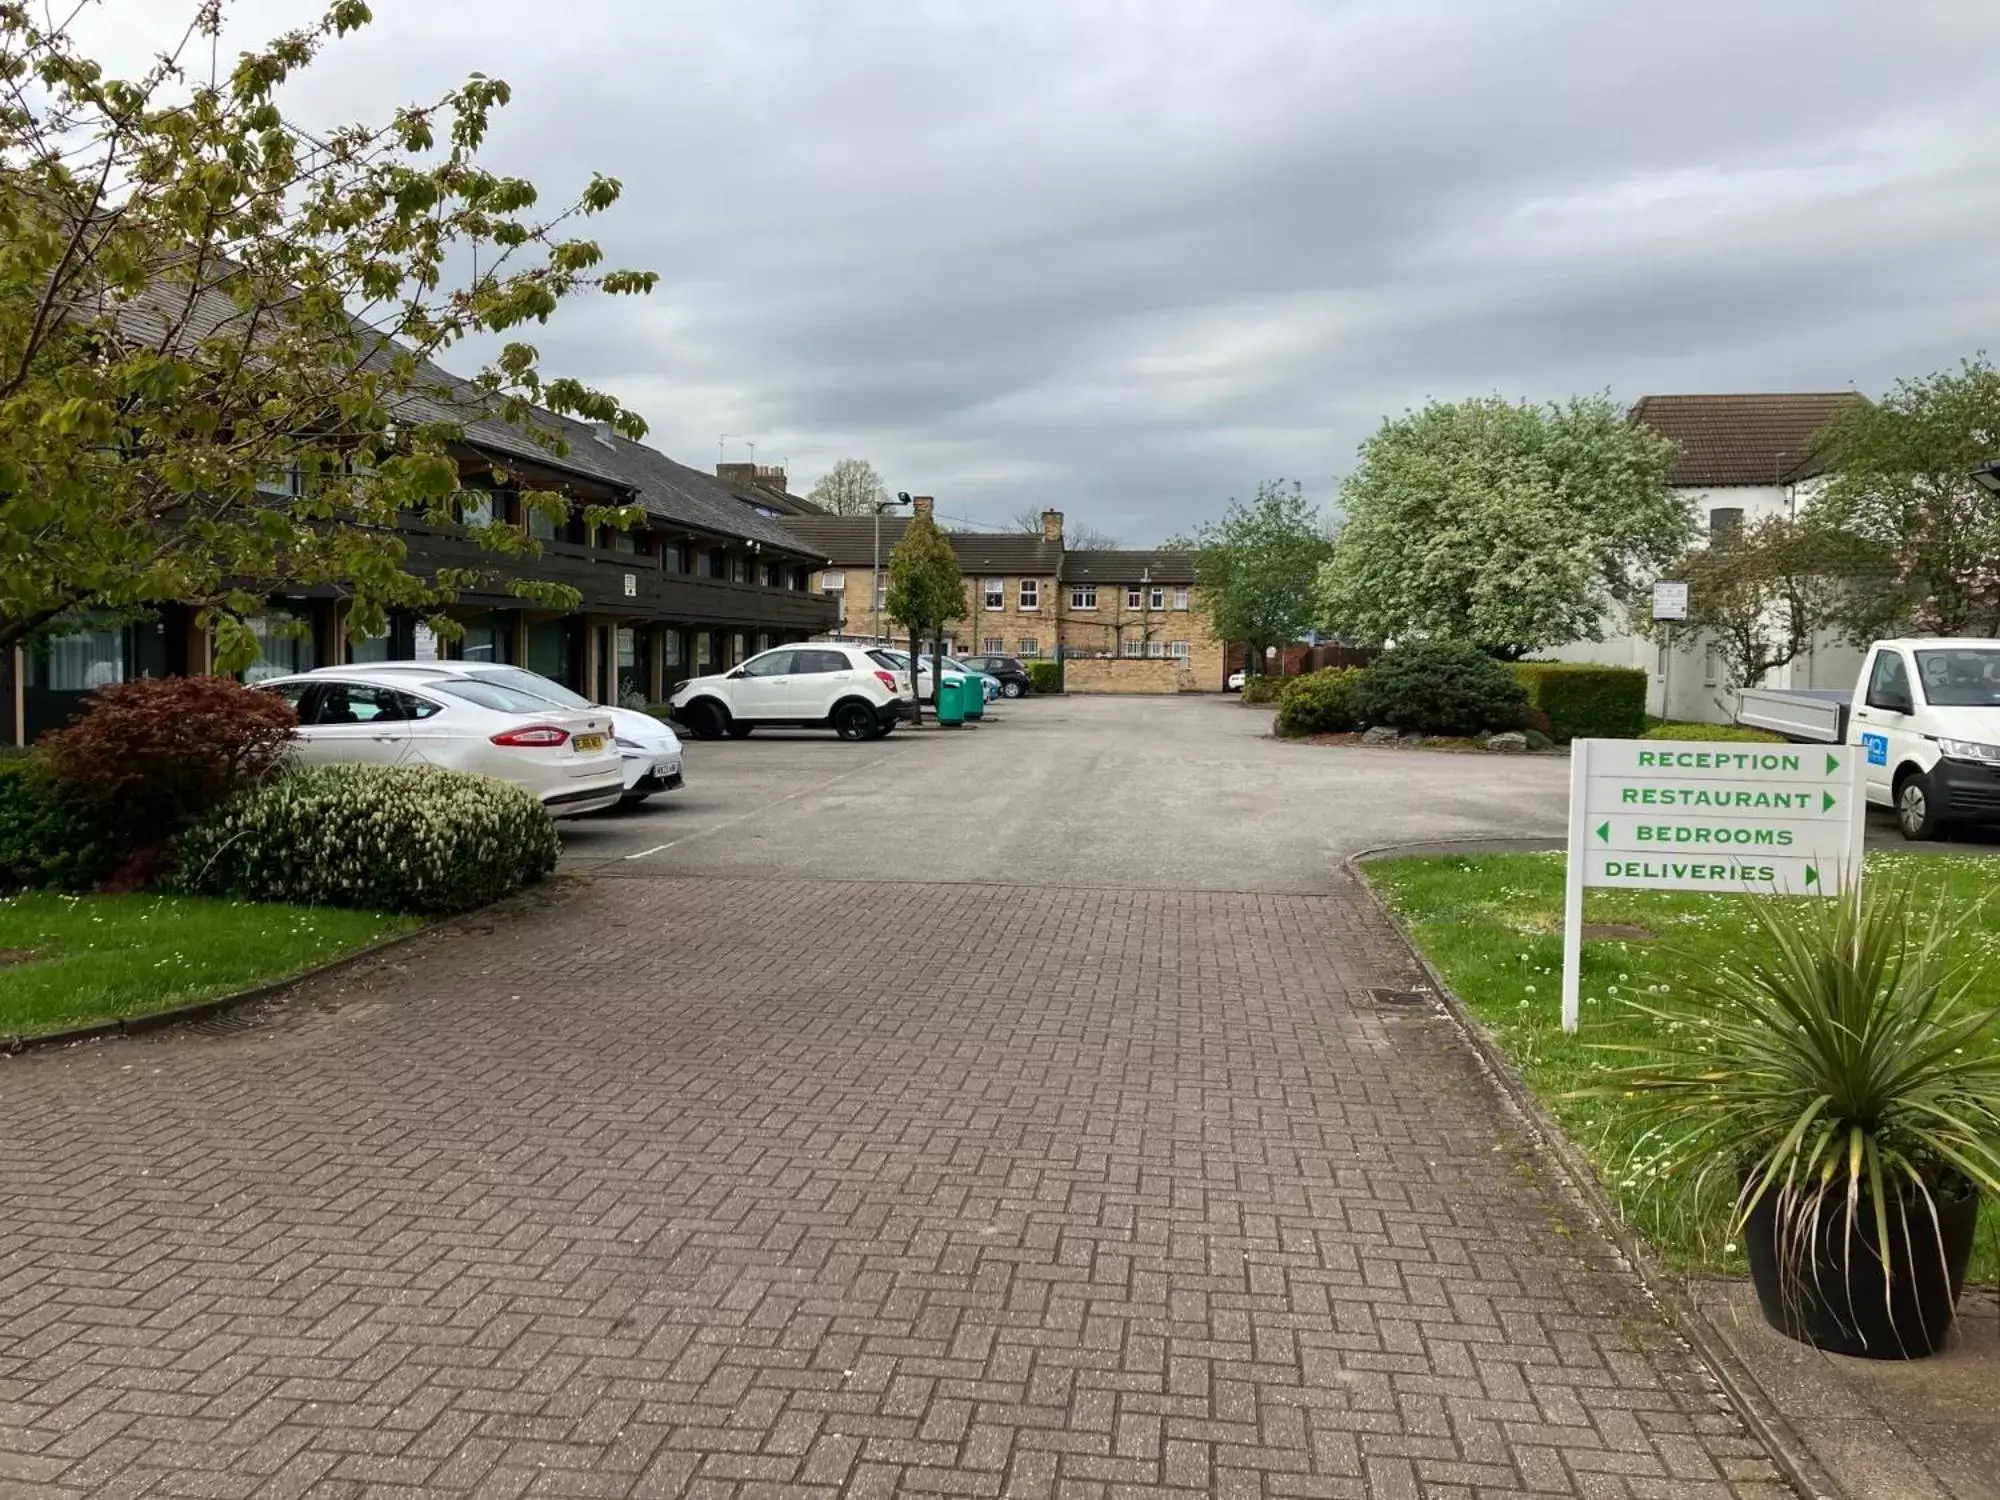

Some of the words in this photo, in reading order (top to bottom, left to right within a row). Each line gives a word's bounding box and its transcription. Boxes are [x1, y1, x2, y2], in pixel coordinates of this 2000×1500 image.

[1639, 751, 1800, 771] RECEPTION
[1622, 788, 1811, 809] RESTAURANT
[1636, 825, 1793, 845] BEDROOMS
[1605, 862, 1775, 881] DELIVERIES
